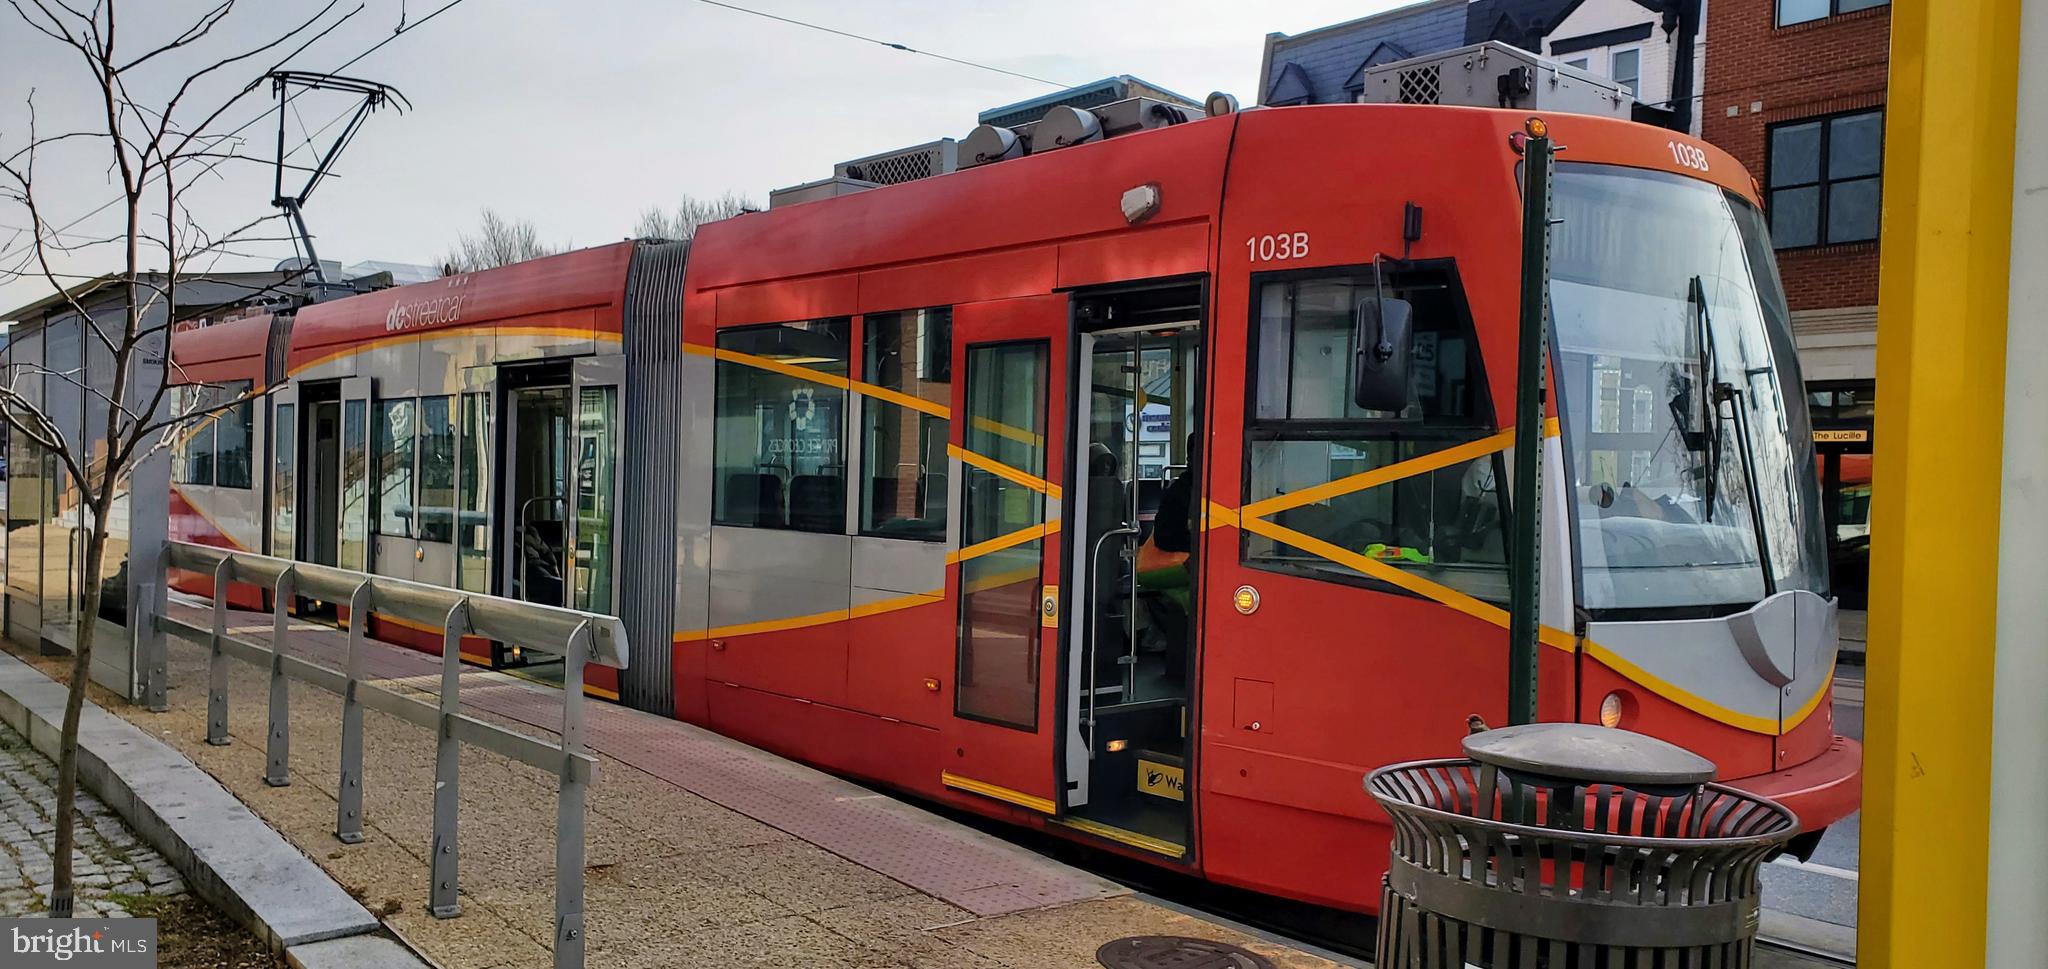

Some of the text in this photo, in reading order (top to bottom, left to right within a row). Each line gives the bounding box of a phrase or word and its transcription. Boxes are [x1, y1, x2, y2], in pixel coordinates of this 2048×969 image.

[1668, 141, 1709, 172] 103B
[1246, 232, 1309, 262] 103B
[386, 294, 467, 332] dcstreetcar
[1814, 432, 1862, 440] The Lucille
